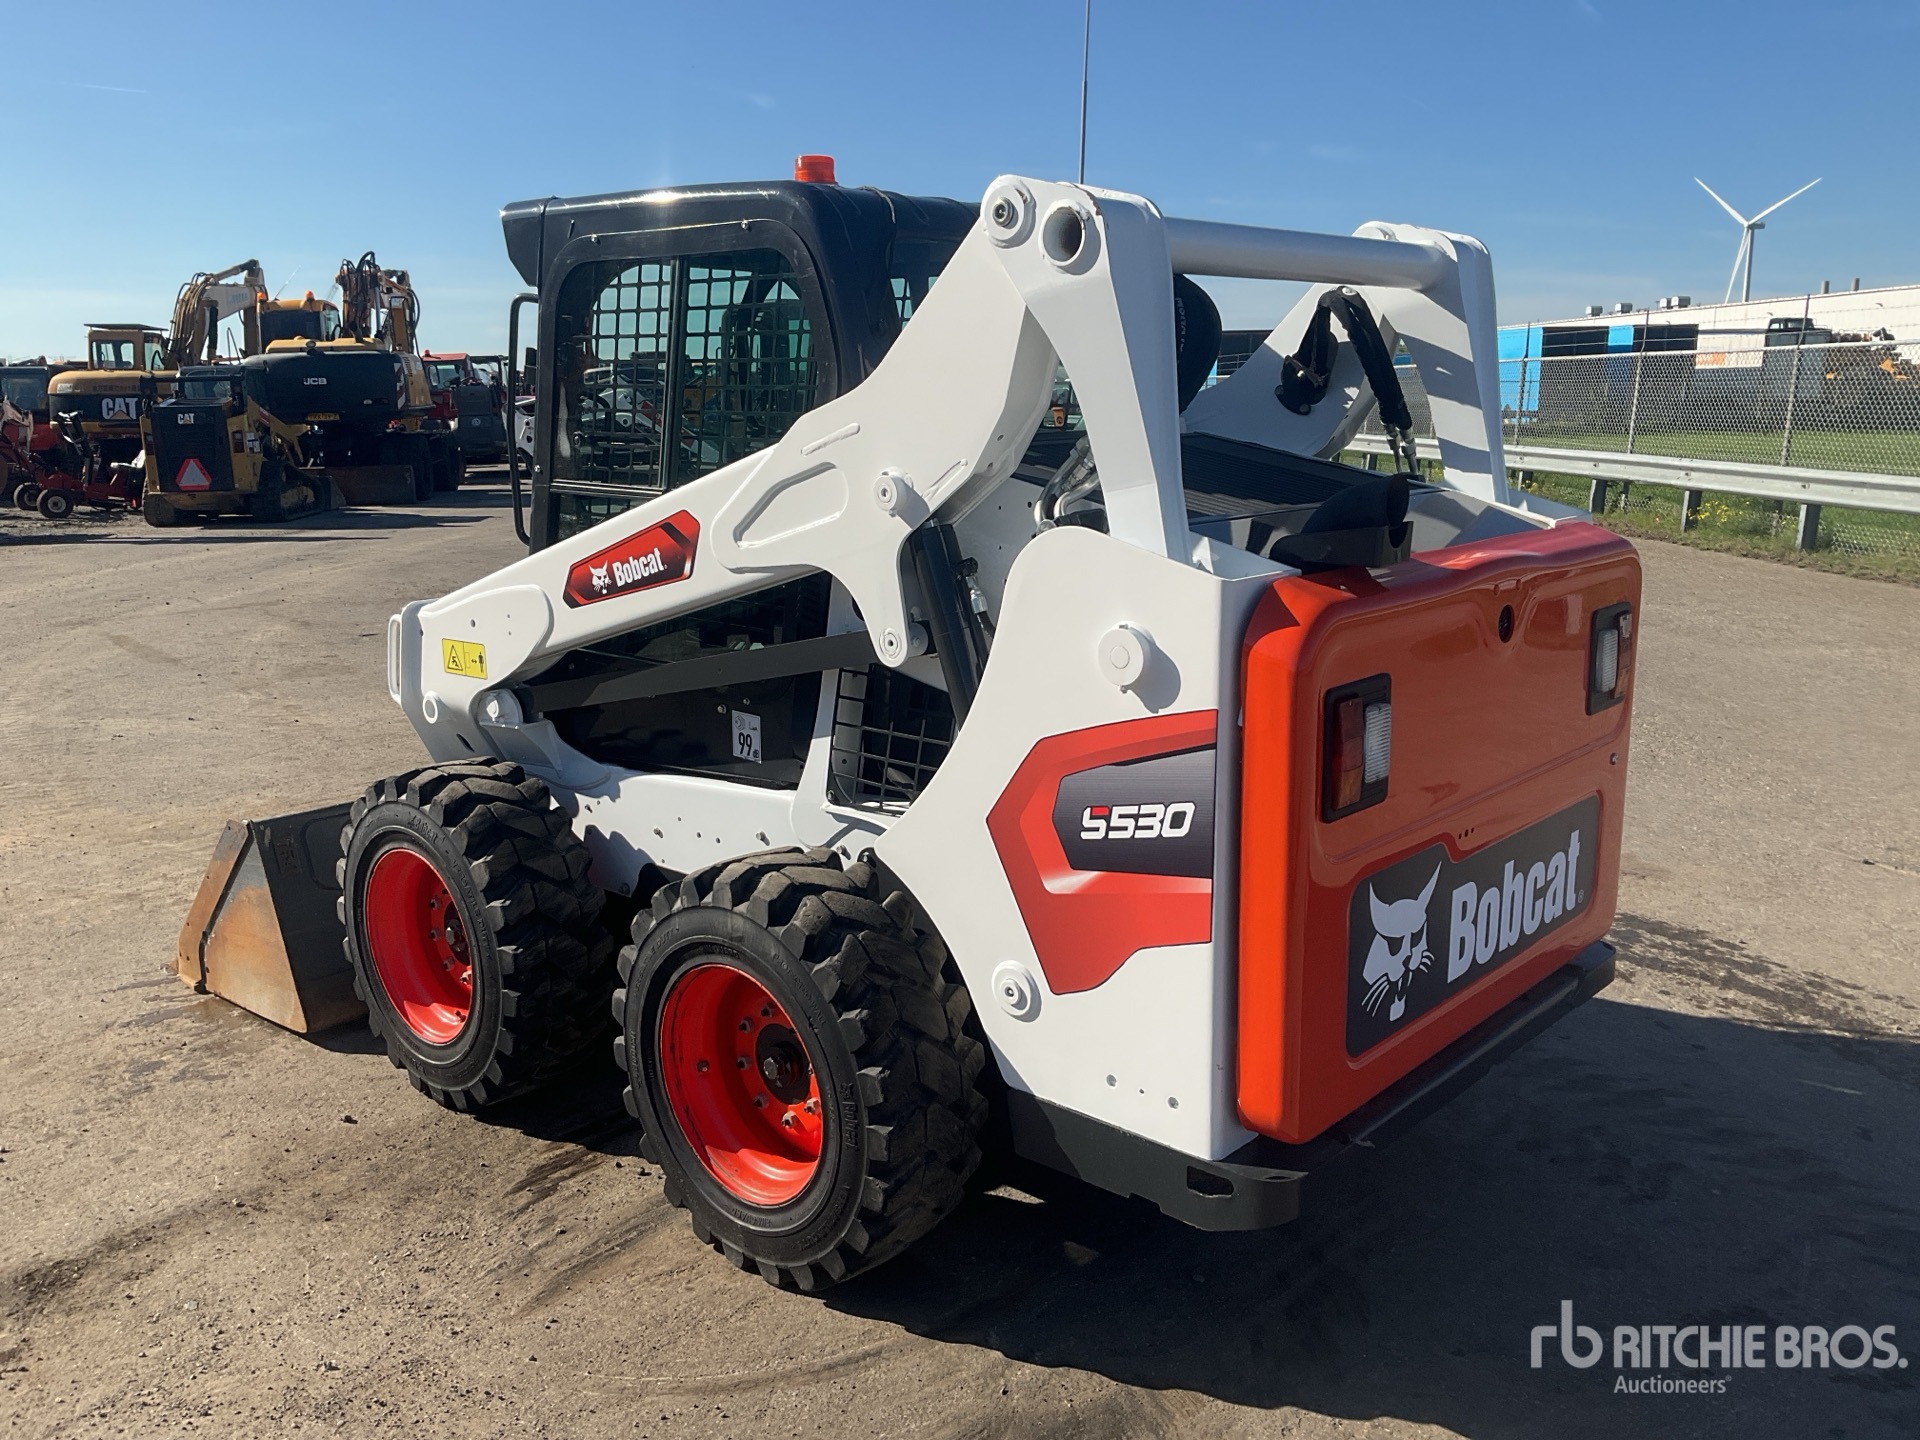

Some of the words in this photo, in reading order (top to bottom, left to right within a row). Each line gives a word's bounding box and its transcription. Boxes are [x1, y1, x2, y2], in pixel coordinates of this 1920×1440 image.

[303, 377, 328, 386] JCB
[101, 397, 138, 420] CAT
[177, 413, 194, 425] CAT
[612, 547, 664, 587] Bobcat
[738, 732, 752, 756] 99
[1080, 802, 1195, 839] S530
[1447, 829, 1581, 983] Bobcat
